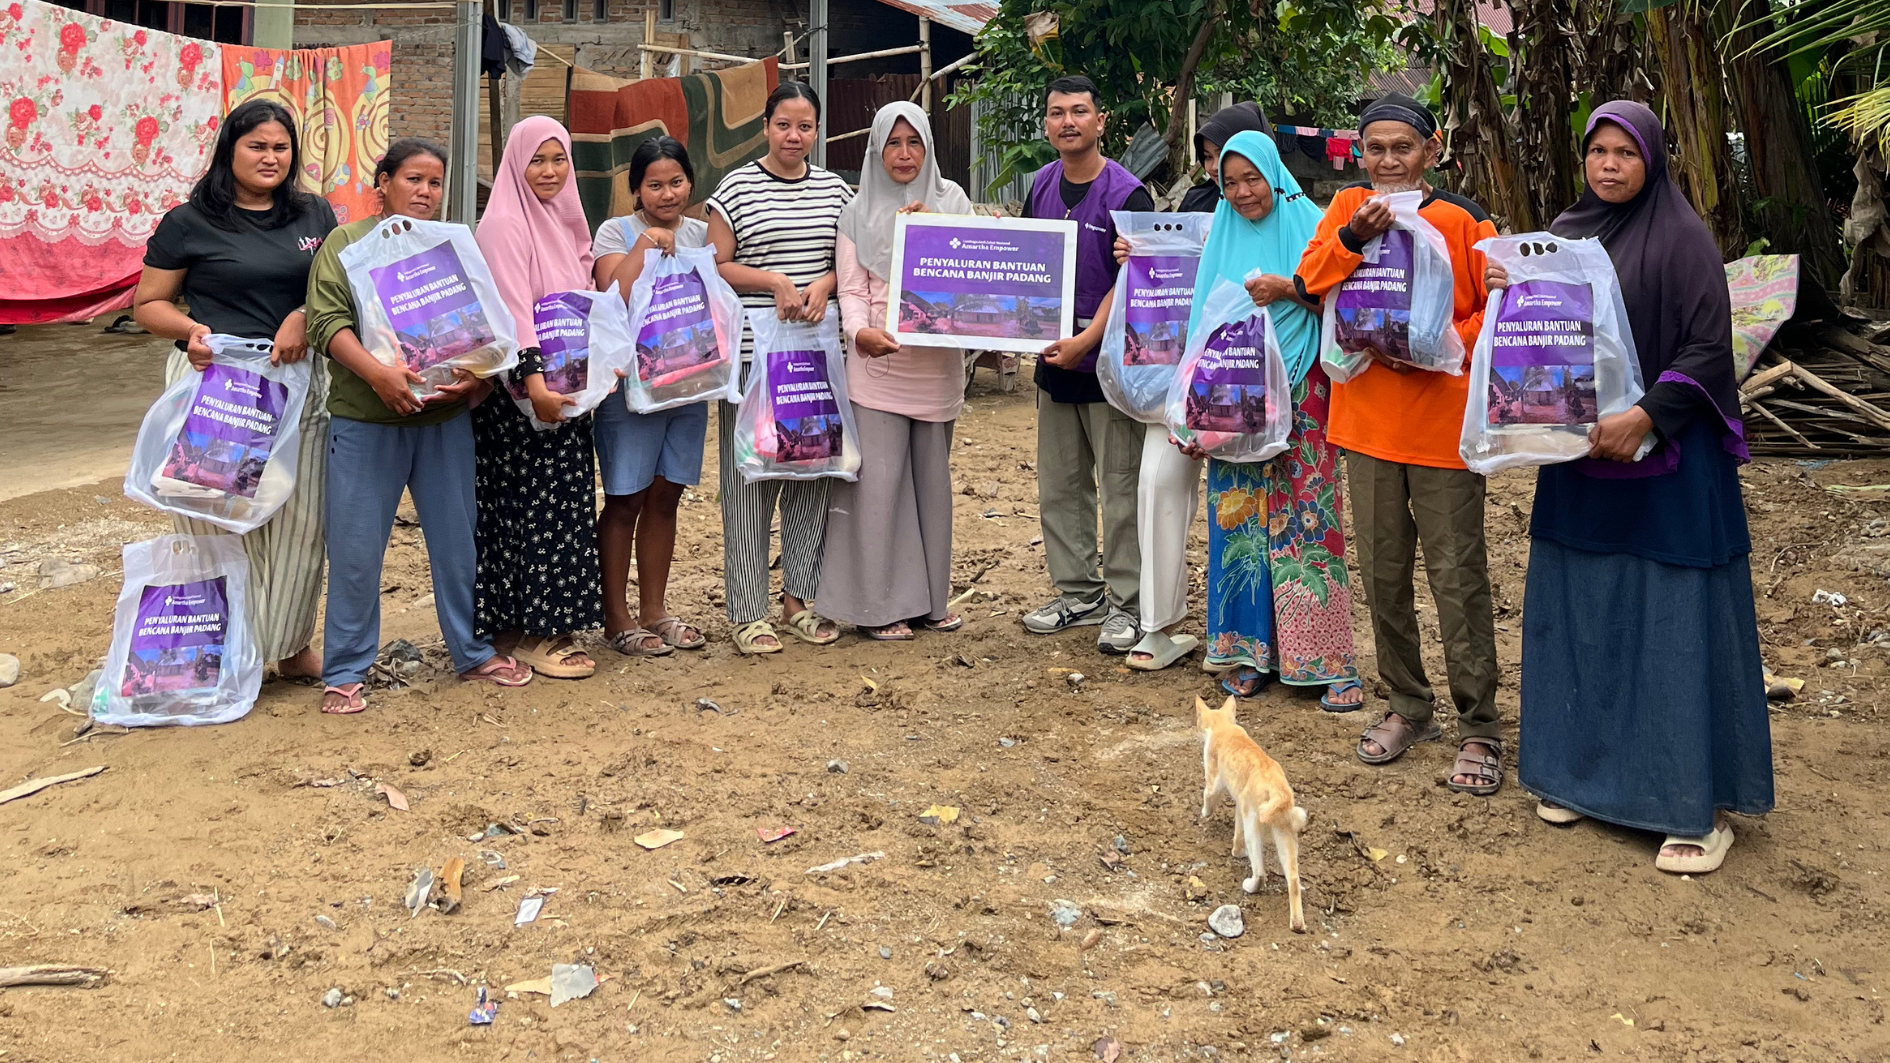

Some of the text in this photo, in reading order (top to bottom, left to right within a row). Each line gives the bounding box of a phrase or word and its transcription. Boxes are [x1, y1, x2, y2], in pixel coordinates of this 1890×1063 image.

[920, 258, 1046, 272] PENYALURAN BANTUAN
[913, 268, 1051, 283] BENCANA BANJIR PADANG
[1376, 268, 1405, 278] BANTUAN
[390, 274, 459, 304] PENYALURAN BANTUAN
[1134, 288, 1168, 297] PENYALURAN
[1363, 281, 1380, 292] BANJIR
[1380, 281, 1407, 292] PADANG
[391, 282, 467, 316] BENCANA BANJIR PADANG
[673, 294, 701, 306] BANTUAN
[1130, 298, 1193, 309] BENCANA BANJIR PADAN
[1541, 300, 1563, 308] Empower
[662, 308, 681, 318] BANJIR
[682, 302, 705, 314] PADANG
[554, 318, 583, 327] BANTUAN
[1497, 320, 1581, 332] PENYALURAN BANTUAN
[560, 329, 585, 337] PADANG
[1494, 335, 1586, 348] BENCANA BANJIR PADANG
[1236, 359, 1259, 368] PADANG
[201, 395, 273, 422] PENYALURAN BANTUAN
[193, 406, 272, 435] BENCANA BANJIR PADANG
[144, 613, 219, 625] PENYALURAN BANTUAN
[139, 623, 221, 636] BENCANA BANJIR PADANG
